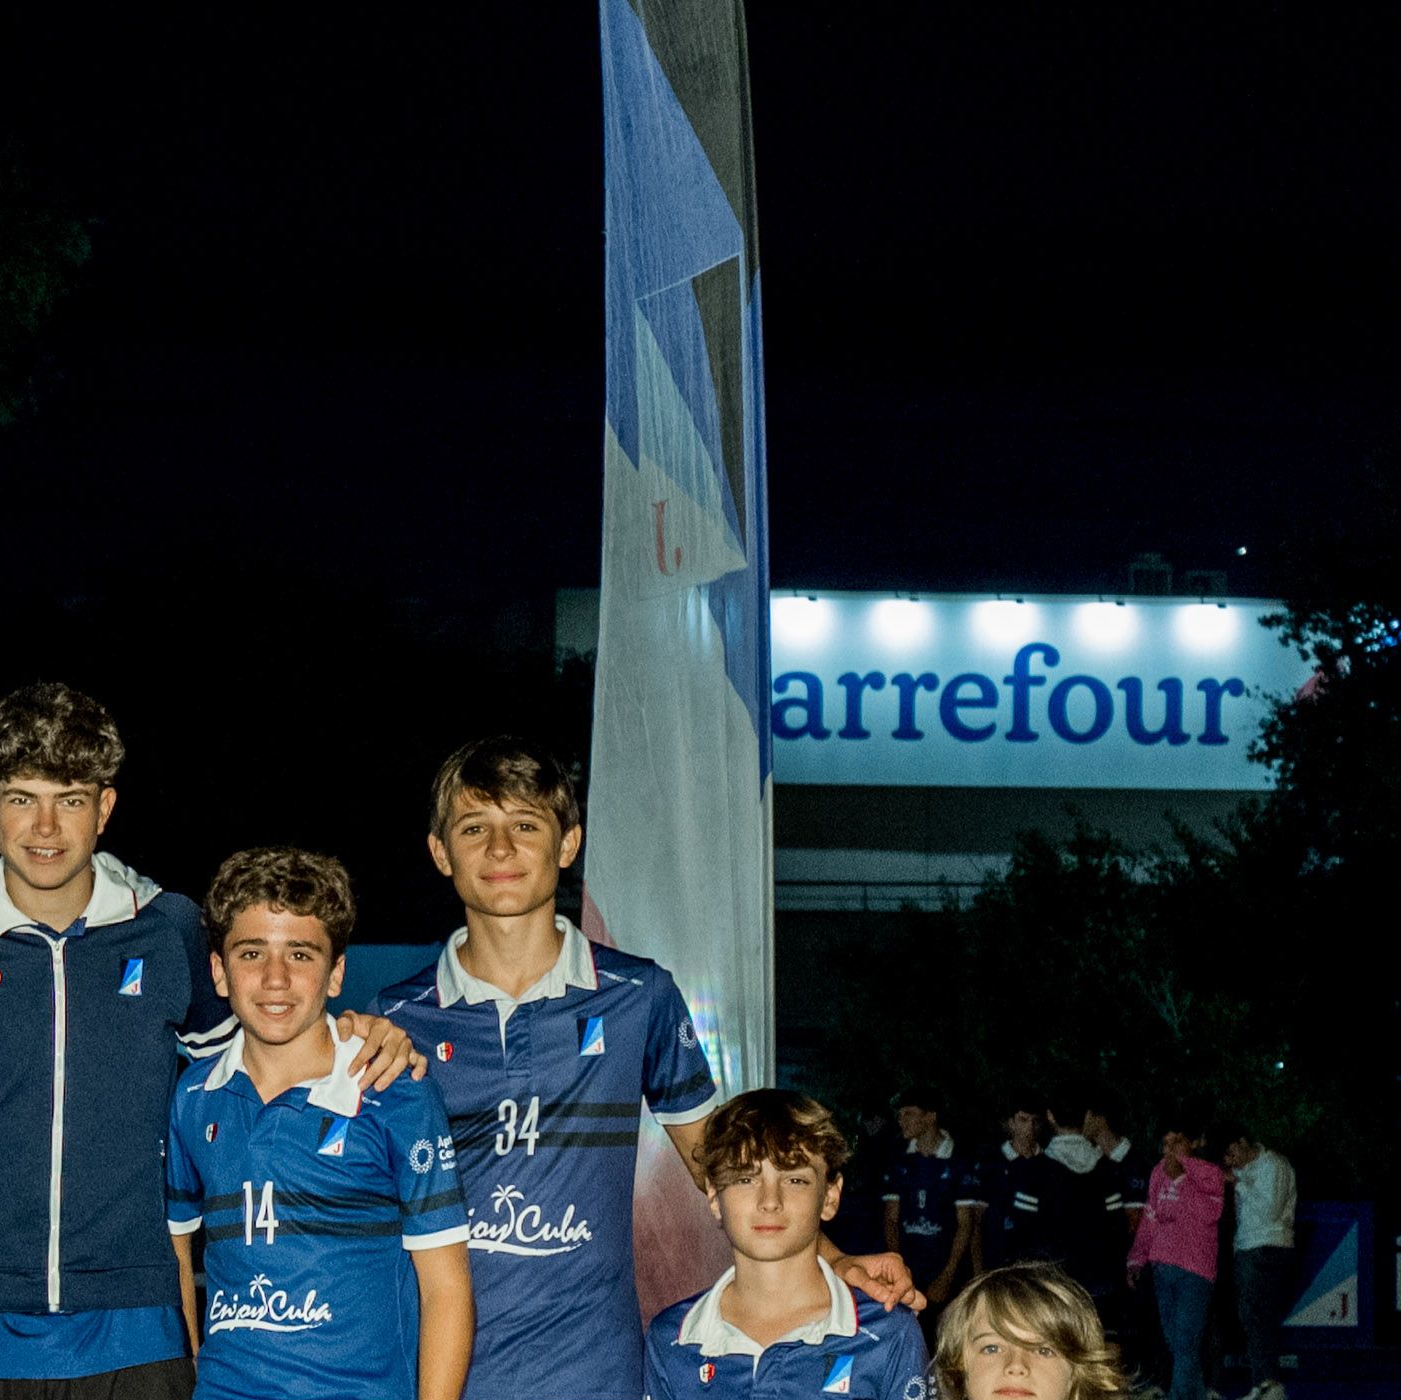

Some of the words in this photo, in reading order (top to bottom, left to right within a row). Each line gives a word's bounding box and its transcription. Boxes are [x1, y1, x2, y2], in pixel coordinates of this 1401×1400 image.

[771, 642, 1245, 746] arrefour
[494, 1096, 540, 1157] 34
[242, 1180, 280, 1246] 14
[467, 1207, 514, 1244] joy
[515, 1203, 593, 1245] Cuba
[209, 1289, 267, 1323] Enjoy
[268, 1289, 332, 1323] Cuba
